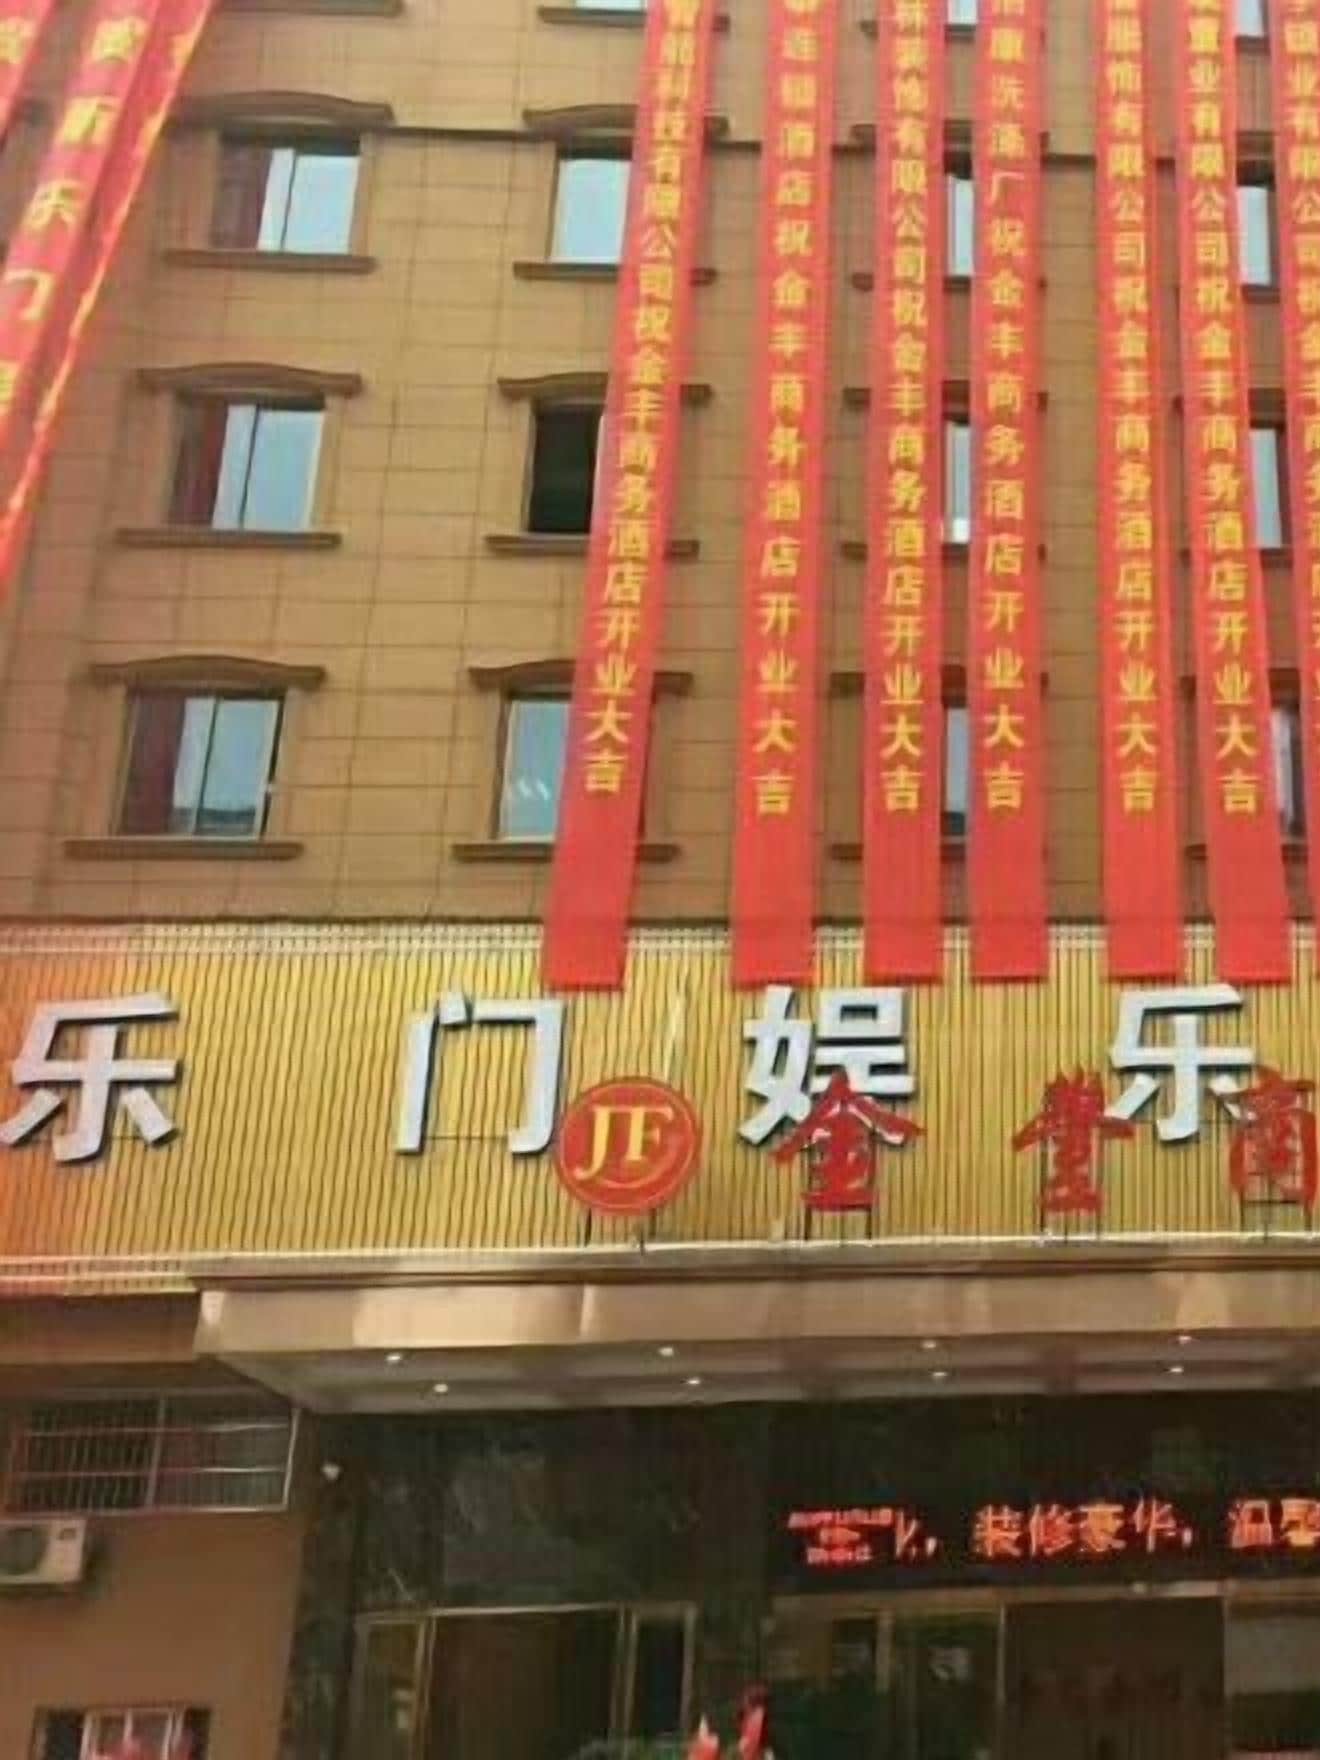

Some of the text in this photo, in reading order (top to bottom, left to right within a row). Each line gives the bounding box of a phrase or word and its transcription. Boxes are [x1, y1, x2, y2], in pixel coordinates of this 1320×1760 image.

[757, 0, 827, 813] 酒店祝金丰商务酒店开业大吉
[885, 0, 930, 810] 有限公司祝金丰商务酒店开业大吉
[1186, 0, 1256, 812] 业有限公司祝金丰商务酒店开业大吉
[575, 1102, 672, 1180] JF
